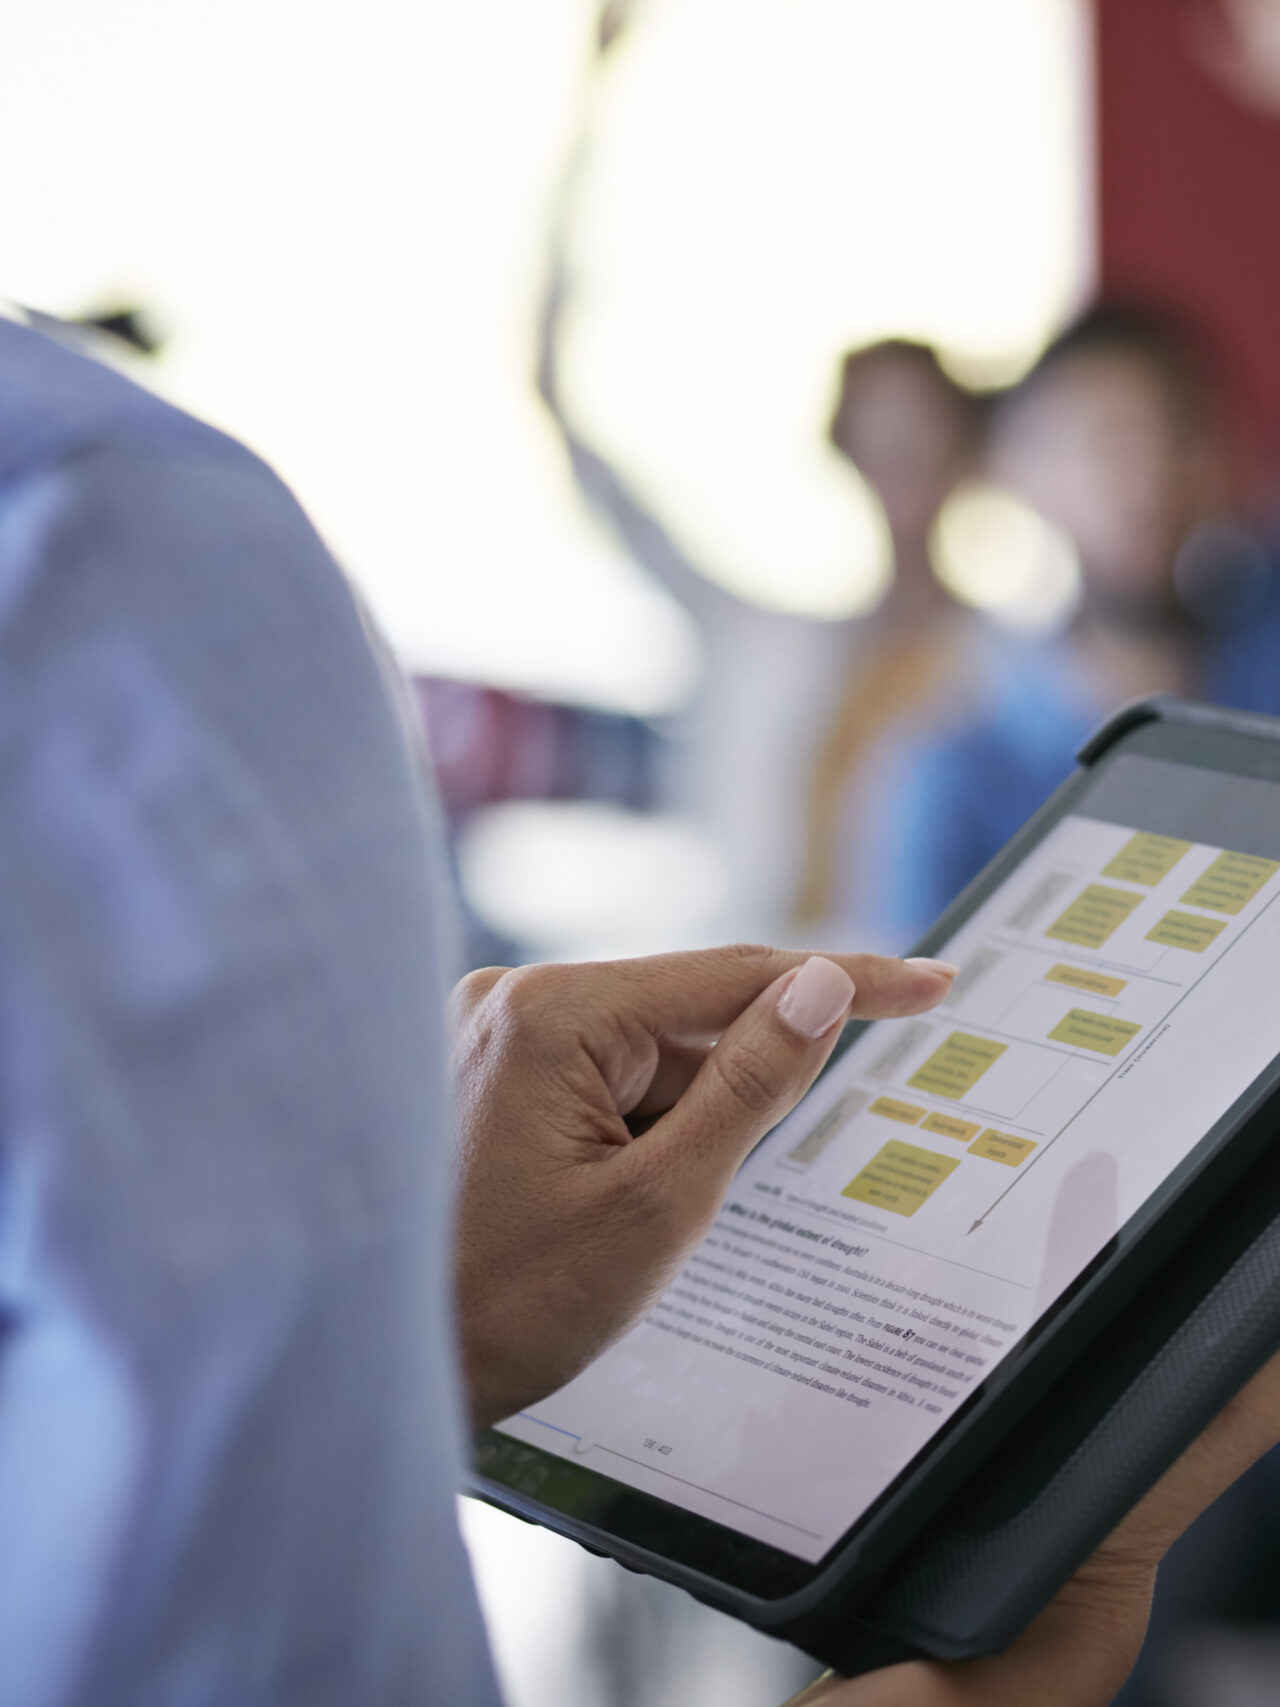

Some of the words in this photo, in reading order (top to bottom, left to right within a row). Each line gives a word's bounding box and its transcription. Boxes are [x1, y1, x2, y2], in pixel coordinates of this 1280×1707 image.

[796, 1228, 823, 1242] extent
[830, 1239, 869, 1256] drought?
[919, 1293, 944, 1306] drought
[872, 1363, 902, 1378] incidence
